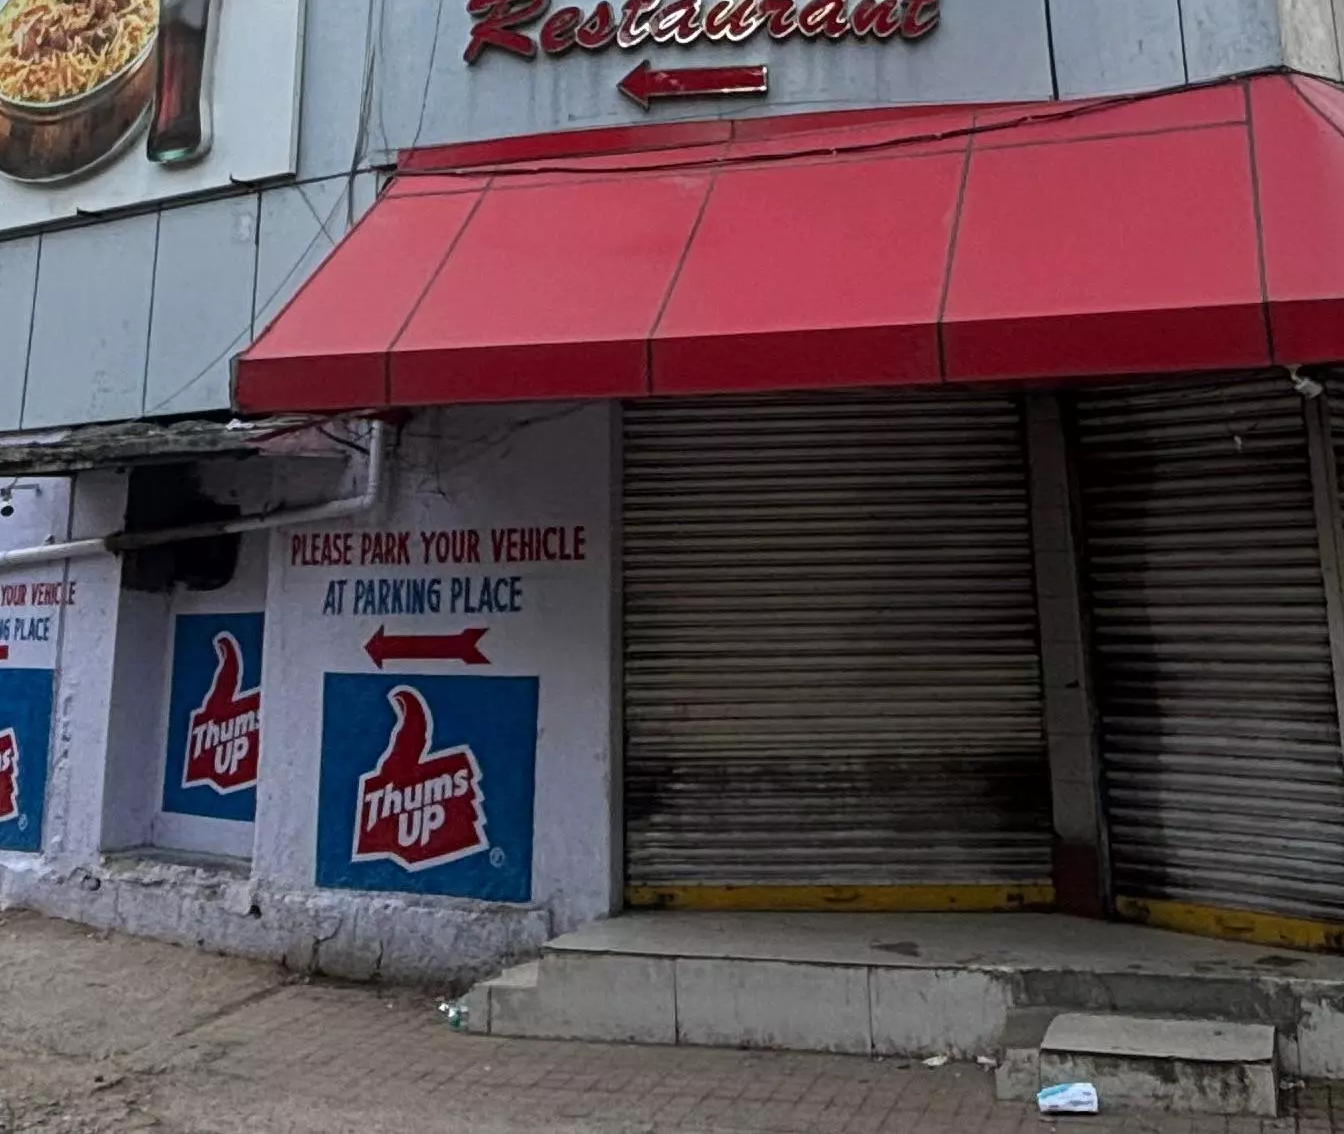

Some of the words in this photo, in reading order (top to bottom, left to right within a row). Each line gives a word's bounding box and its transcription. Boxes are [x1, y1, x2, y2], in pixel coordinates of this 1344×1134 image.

[291, 531, 354, 566] PLEASE
[360, 530, 411, 565] PARK
[420, 528, 481, 564] YOUR
[490, 525, 587, 563] VEHICLE
[0, 583, 28, 607] YOUR
[31, 580, 77, 606] VEHICLE
[322, 578, 348, 615] AT
[354, 577, 442, 615] PARKING
[450, 575, 524, 613] PLACE
[13, 617, 51, 641] PLACE
[214, 736, 250, 776] UP
[364, 768, 469, 833] Thums
[397, 804, 446, 848] UP
